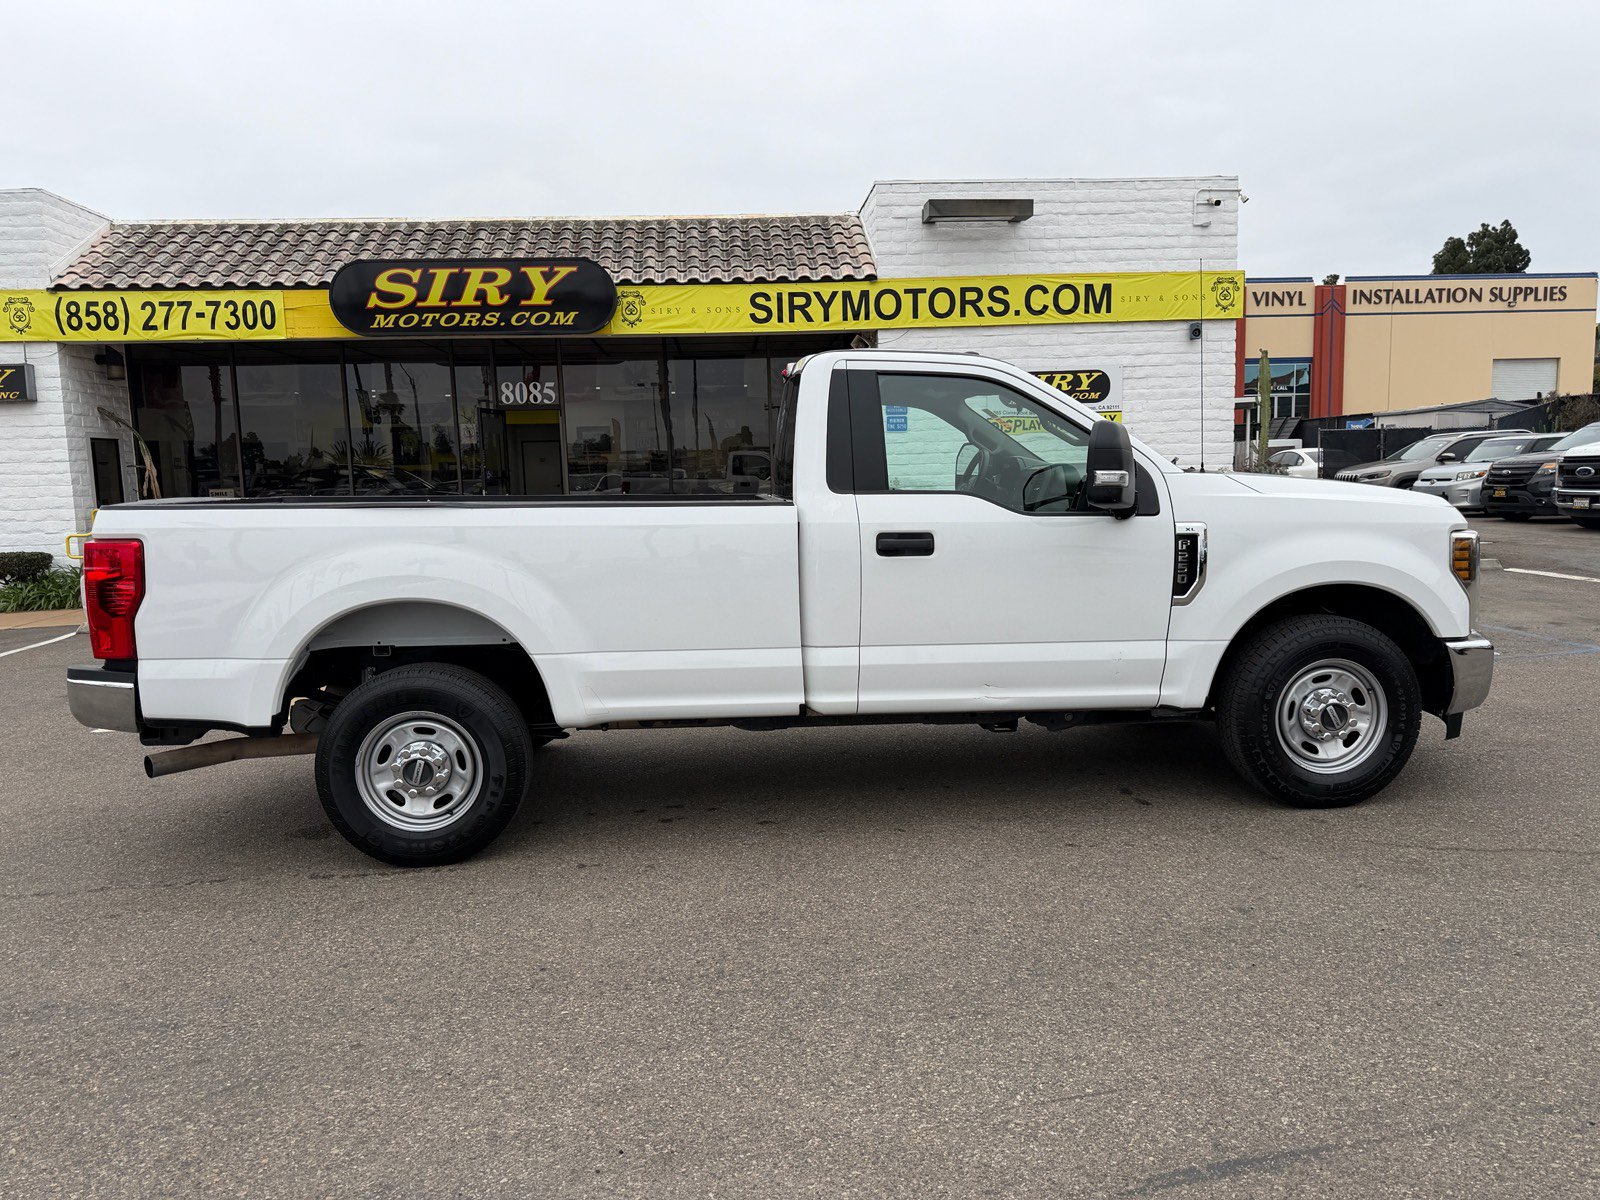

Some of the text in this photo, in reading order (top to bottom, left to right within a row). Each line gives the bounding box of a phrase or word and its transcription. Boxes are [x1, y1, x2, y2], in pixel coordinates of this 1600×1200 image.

[365, 265, 578, 309] SIRY
[1352, 285, 1567, 305] INSTALLATION SUPPLIES
[749, 283, 1112, 324] SIRYMOTORS.COM
[1120, 295, 1150, 303] SIRY
[1173, 293, 1206, 302] SONS
[1252, 291, 1306, 307] VINYL
[55, 297, 276, 335] (858) 277-7300
[370, 311, 579, 328] MOTORS.COM
[650, 306, 741, 315] SIRY & SONS
[501, 381, 556, 404] 8085
